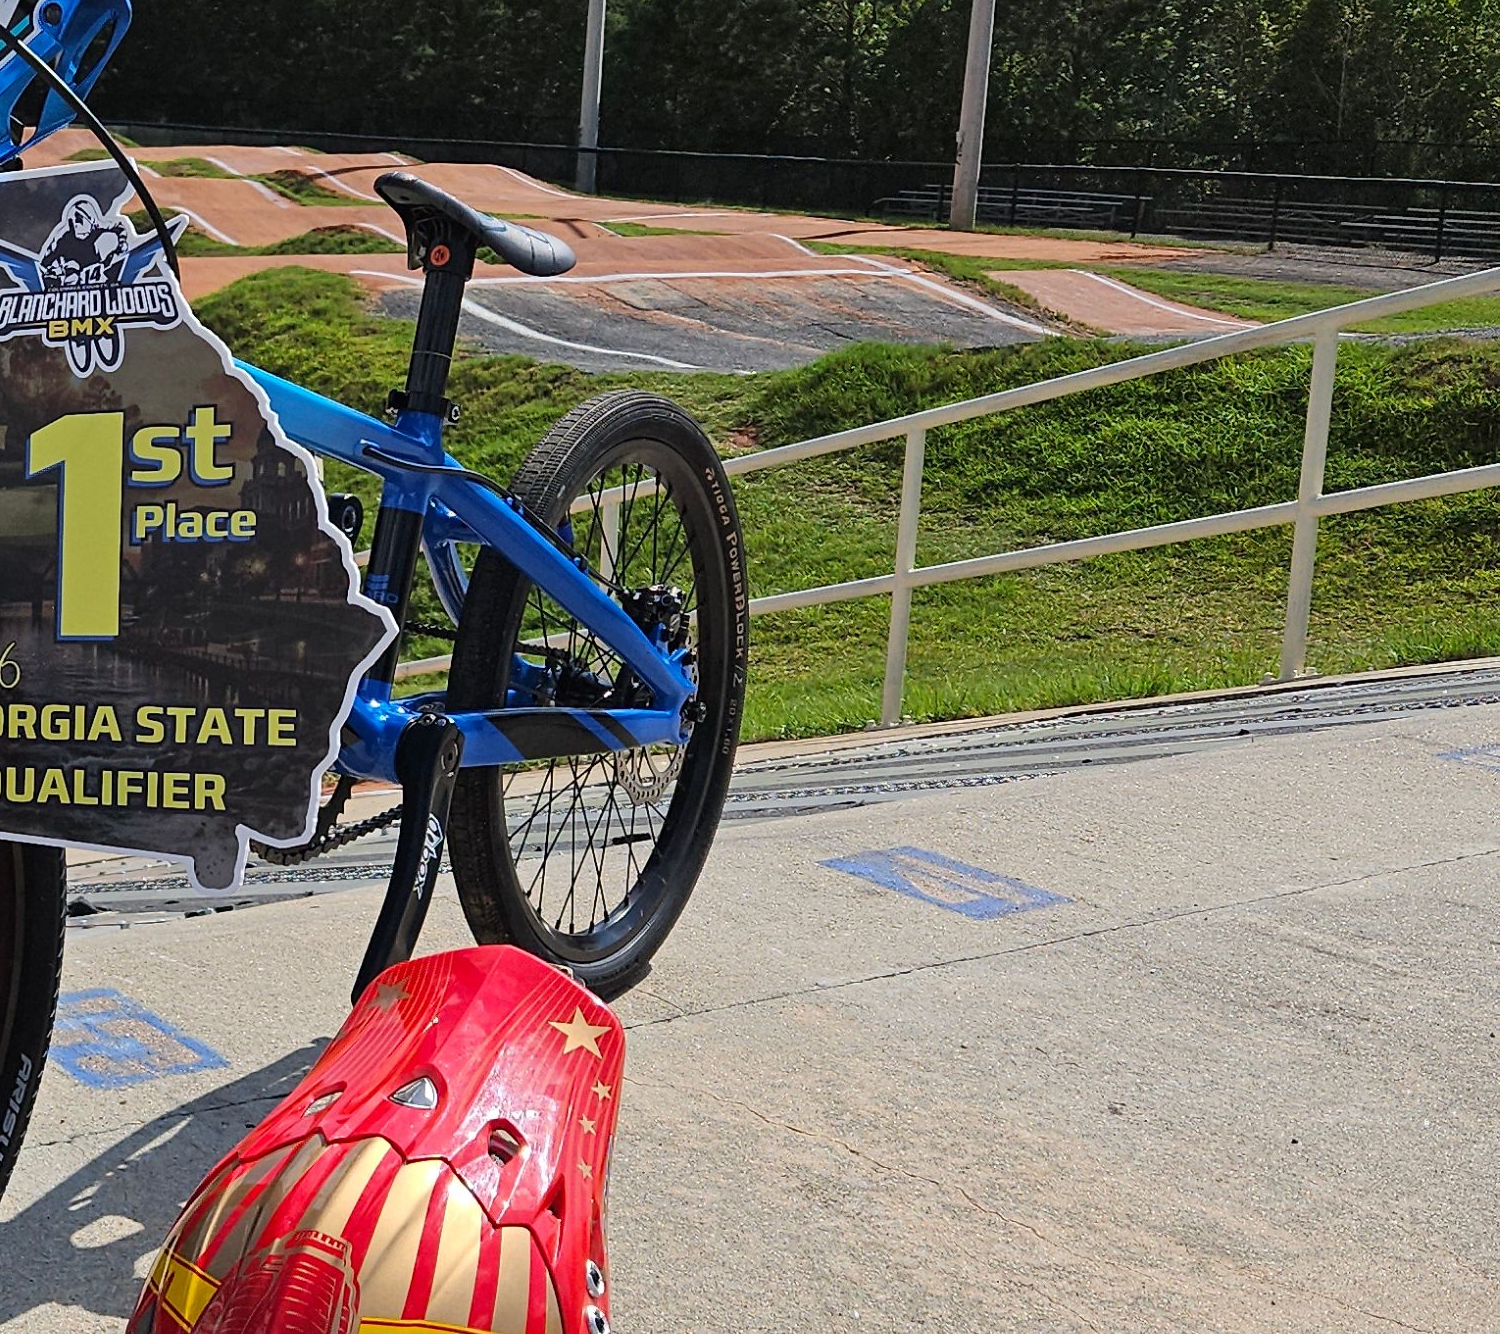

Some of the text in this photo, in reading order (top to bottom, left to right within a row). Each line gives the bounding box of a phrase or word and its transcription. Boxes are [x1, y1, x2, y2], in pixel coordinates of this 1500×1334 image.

[105, 283, 176, 318] WOODS
[48, 316, 115, 339] BMX
[27, 406, 234, 639] 1st
[133, 502, 257, 541] Place
[711, 480, 731, 526] TIOGA
[135, 706, 298, 747] STATE
